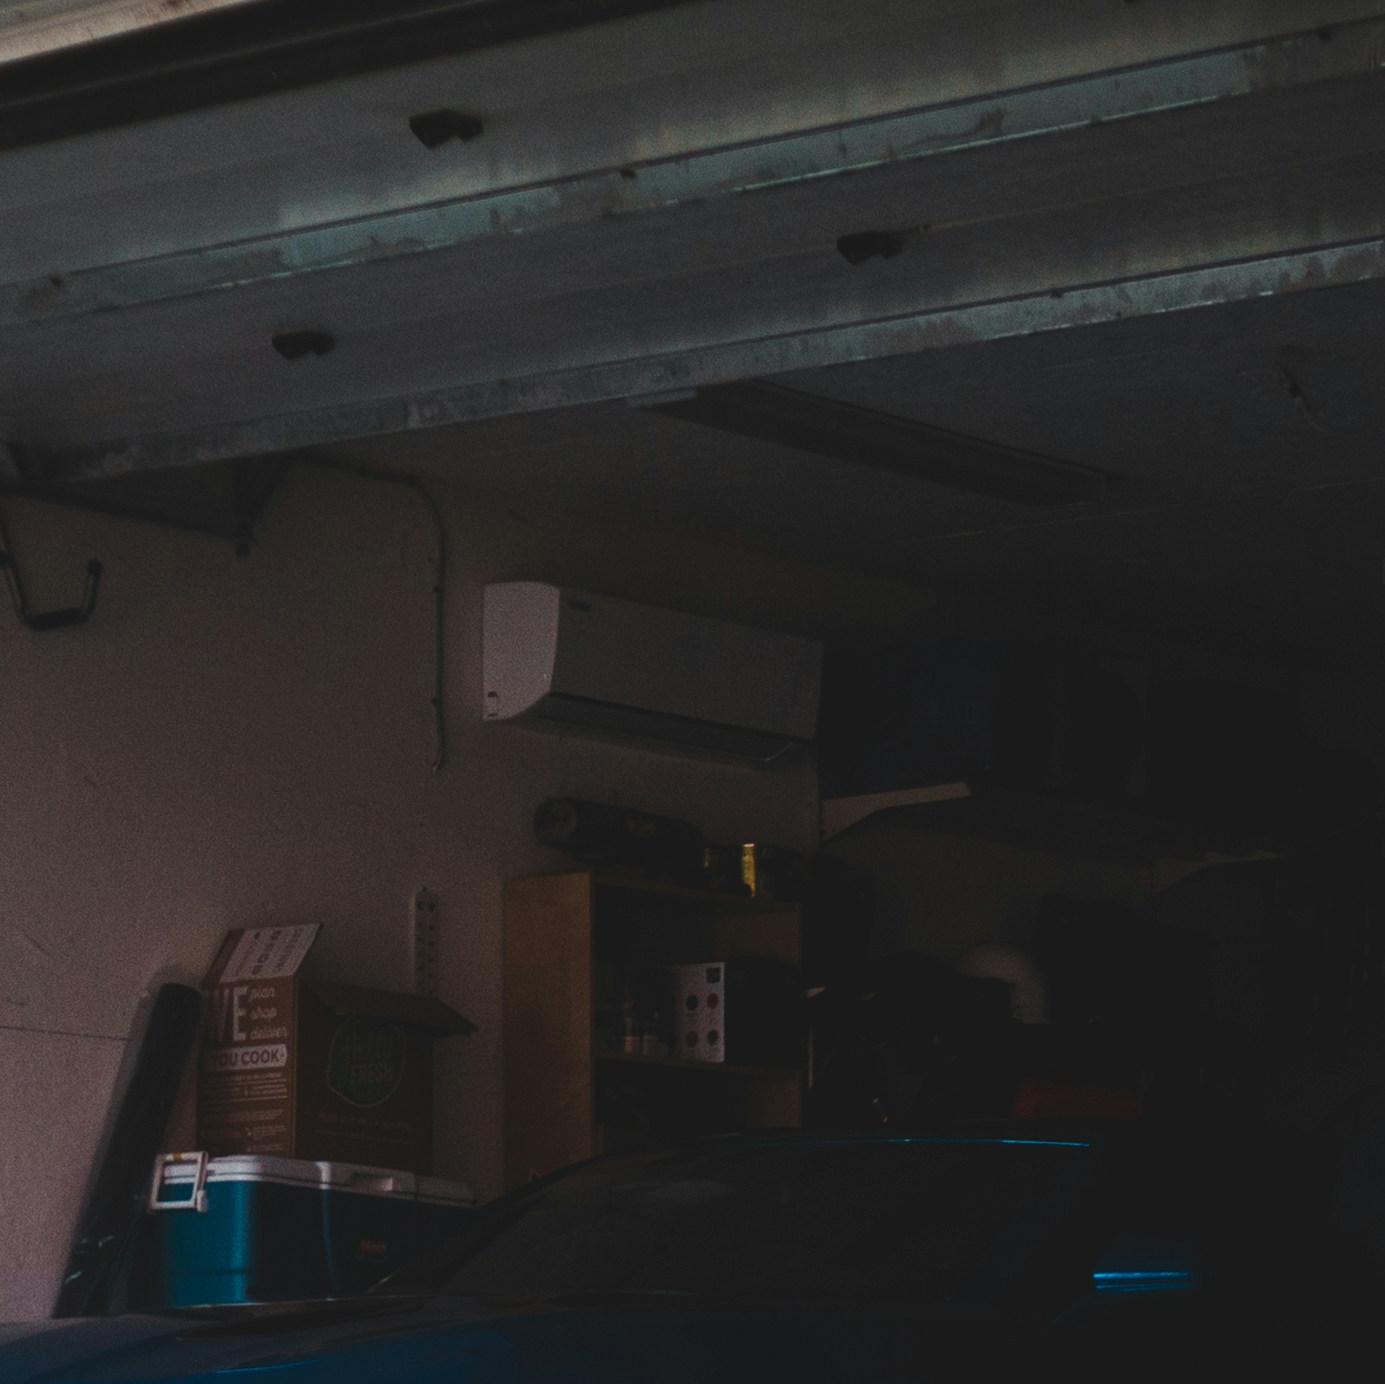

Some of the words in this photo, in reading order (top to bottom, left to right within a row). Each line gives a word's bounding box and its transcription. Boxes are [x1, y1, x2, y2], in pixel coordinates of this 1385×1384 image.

[247, 985, 276, 1003] plan
[249, 1006, 278, 1022] shop
[249, 1025, 289, 1040] deliver
[241, 1048, 280, 1065] COOK
